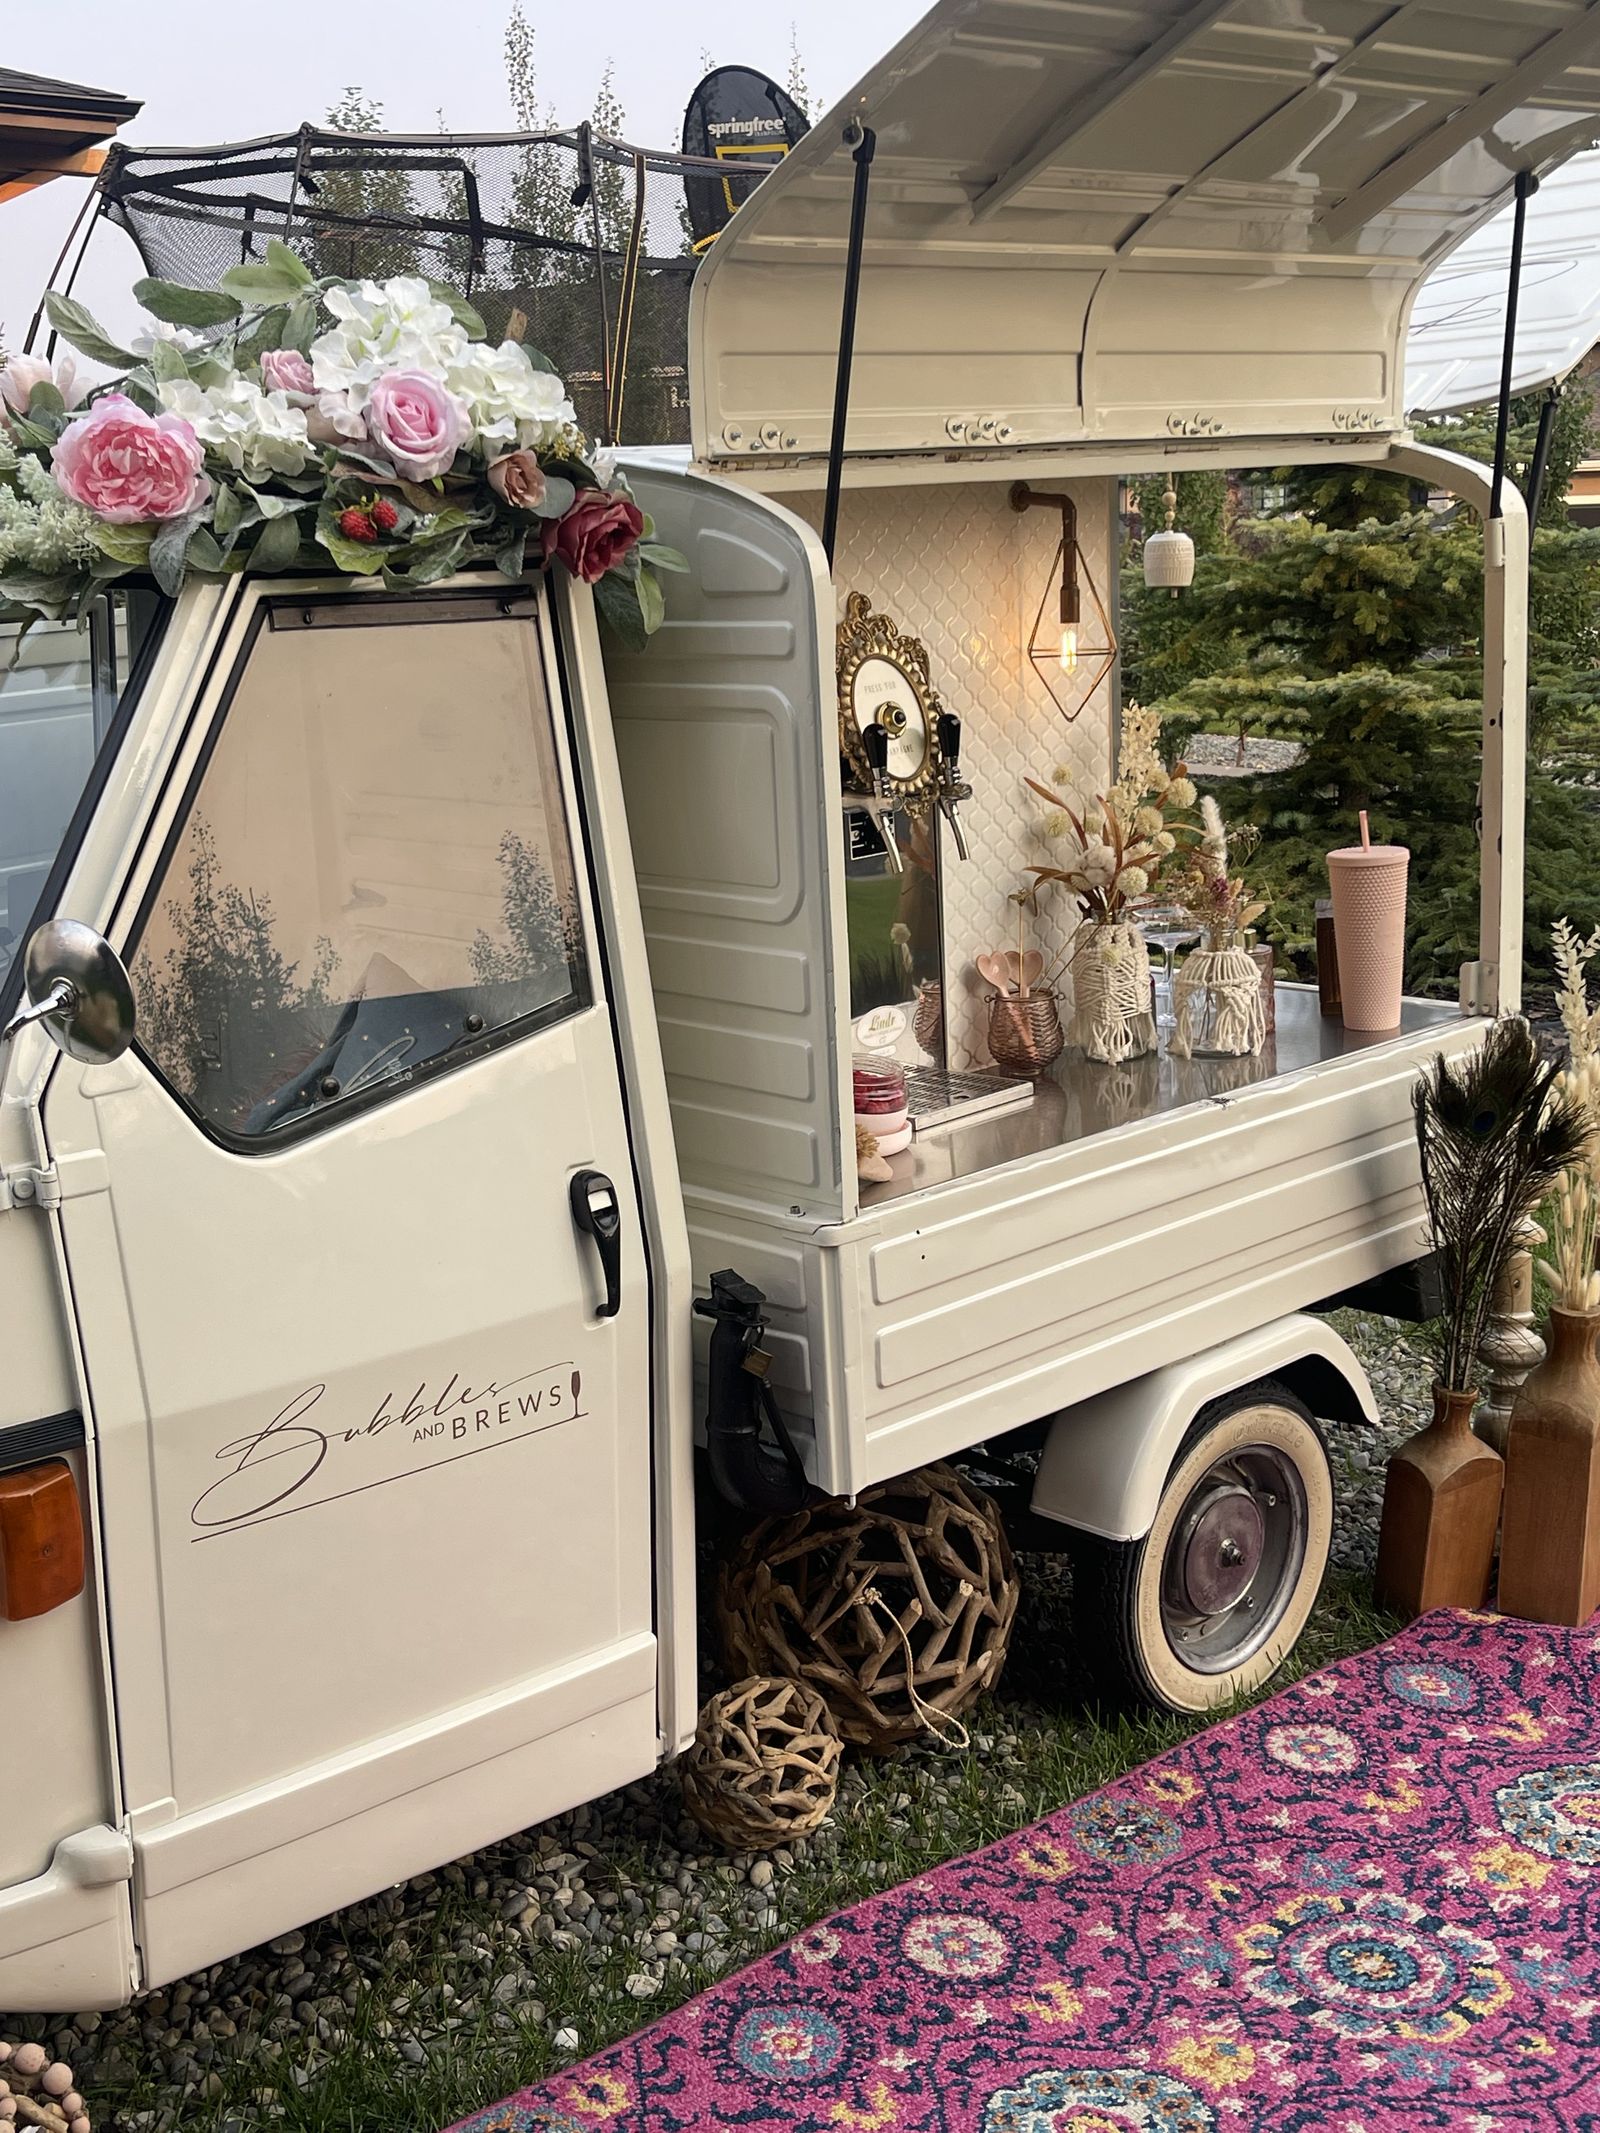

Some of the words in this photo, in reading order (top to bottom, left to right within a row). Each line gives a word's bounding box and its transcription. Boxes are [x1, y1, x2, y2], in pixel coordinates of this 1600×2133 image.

[707, 117, 784, 138] springfree
[191, 1361, 574, 1527] Bubbles
[412, 1421, 445, 1444] AND
[452, 1384, 562, 1440] BREWS
